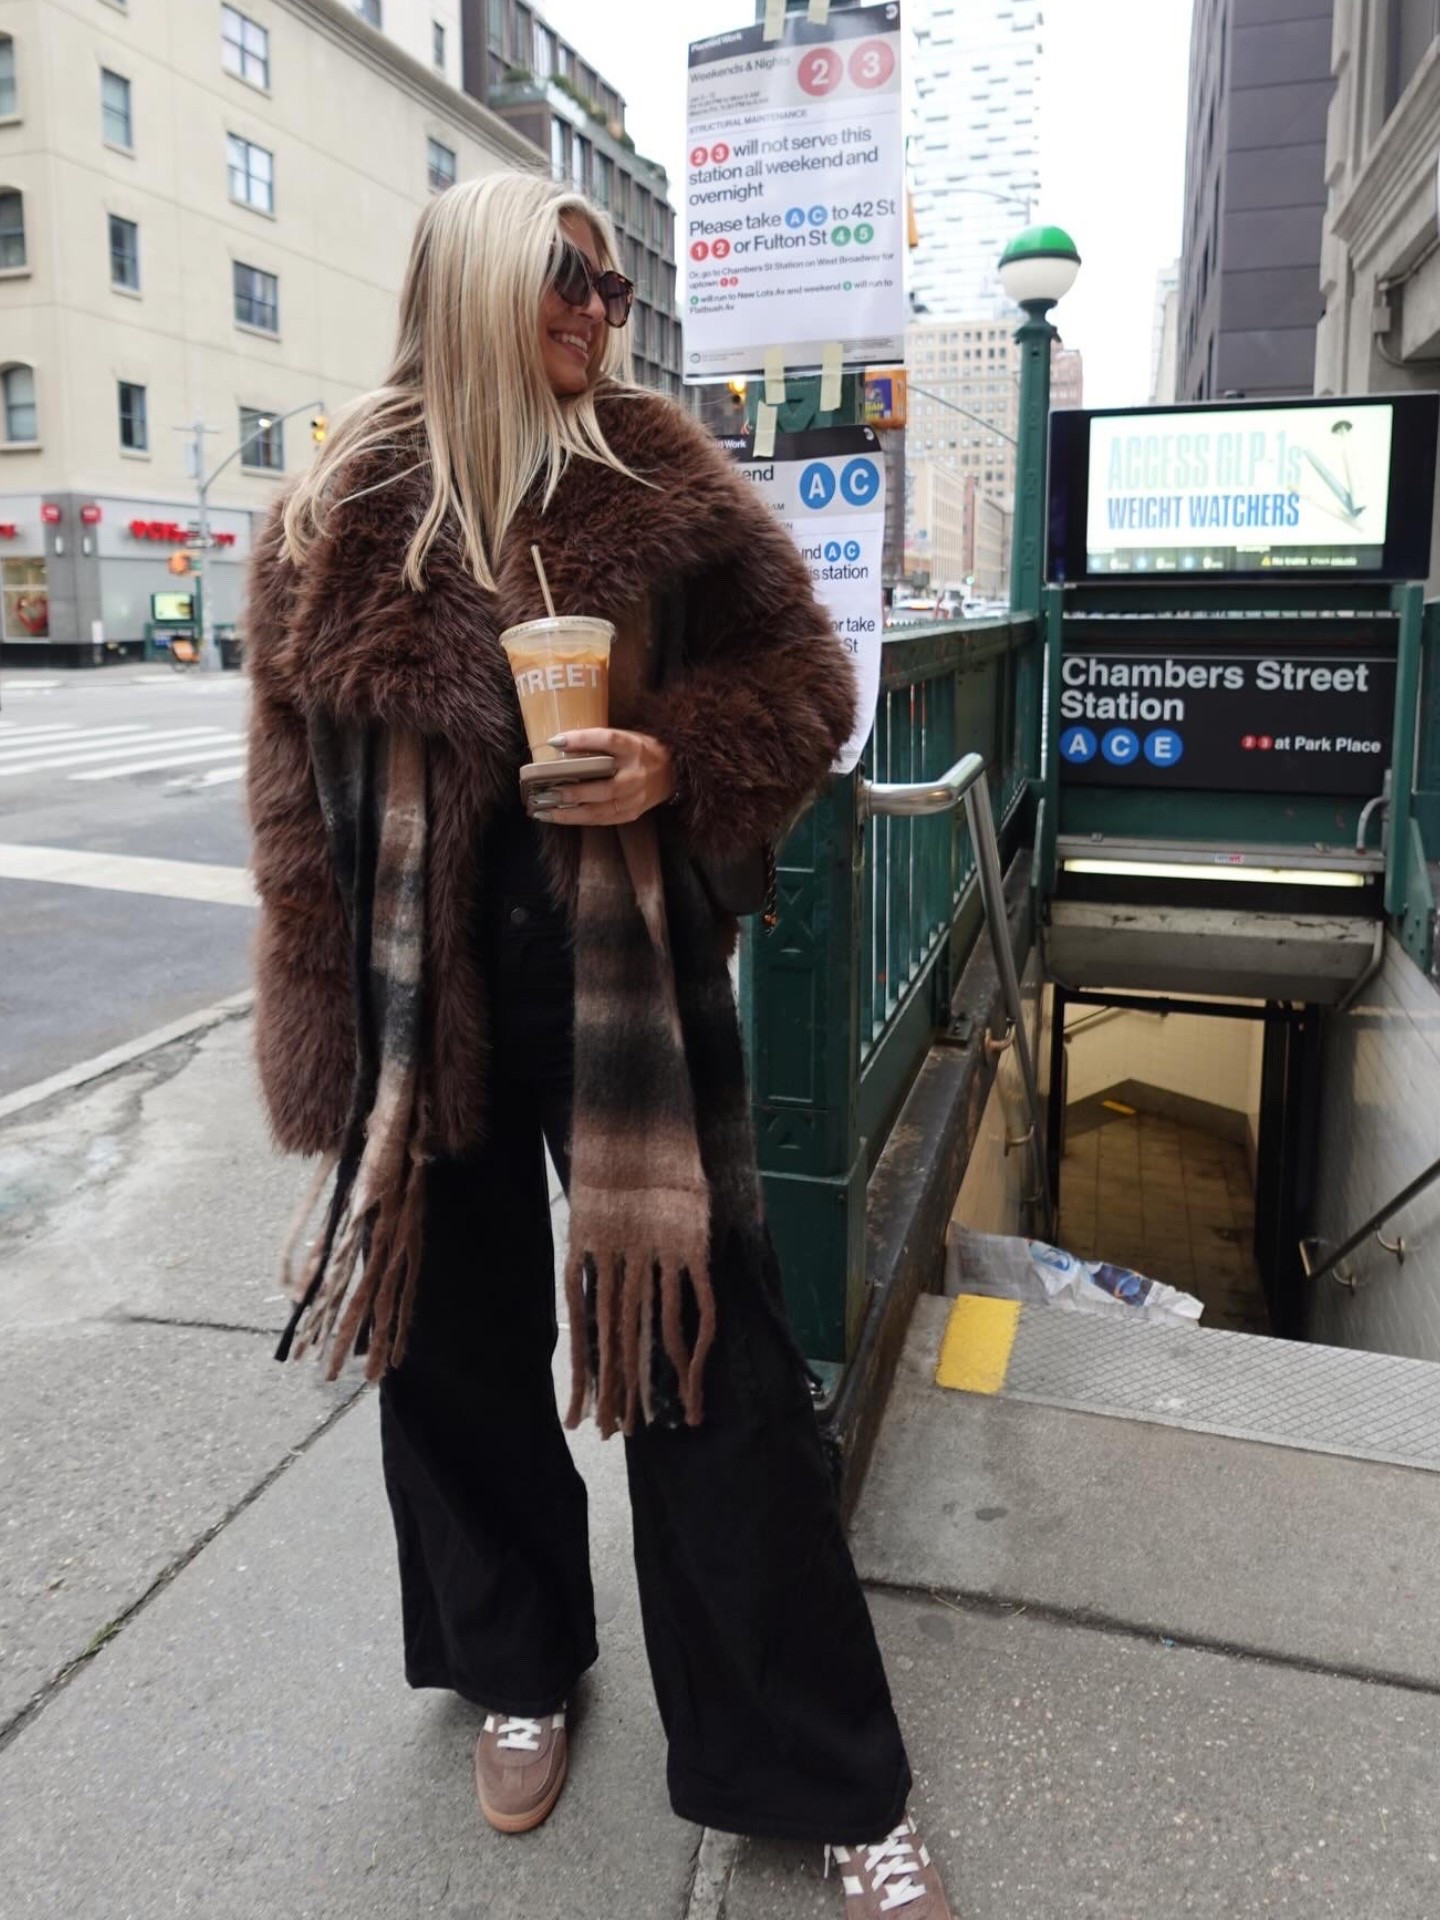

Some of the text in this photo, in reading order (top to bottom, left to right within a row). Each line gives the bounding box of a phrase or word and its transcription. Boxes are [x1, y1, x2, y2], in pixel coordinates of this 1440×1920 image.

[690, 62, 744, 82] Weekends
[746, 60, 753, 71] &
[689, 109, 807, 134] STRUCTURAL MAINTENANCE
[733, 138, 759, 157] will
[762, 136, 789, 154] not
[791, 133, 838, 151] serve
[841, 127, 873, 145] this
[689, 145, 879, 186] station all weekend and
[689, 182, 763, 206] overnight
[689, 218, 743, 237] Please
[746, 212, 782, 230] take
[832, 204, 849, 221] to
[851, 201, 874, 218] 42
[876, 198, 896, 216] St
[733, 240, 751, 254] or
[754, 232, 806, 252] Fulton
[808, 229, 828, 247] St
[721, 264, 763, 275] Chambers
[764, 262, 773, 271] St
[774, 260, 804, 271] Station
[805, 259, 816, 267] on
[817, 257, 838, 266] West
[737, 291, 755, 300] New
[803, 283, 841, 293] weekend
[689, 304, 724, 314] Flatbush
[725, 439, 747, 449] Work
[1107, 430, 1302, 490] ACCESS GLP-1s
[1107, 493, 1301, 530] WEIGHT WATCHERS
[822, 563, 869, 581] station
[832, 616, 876, 632] or take
[844, 637, 859, 654] St
[515, 663, 600, 698] TREET
[1061, 657, 1369, 693] Chambers Street
[1060, 689, 1185, 722] Station
[1274, 737, 1291, 750] at
[1294, 736, 1331, 752] Park
[1335, 737, 1382, 754] Place
